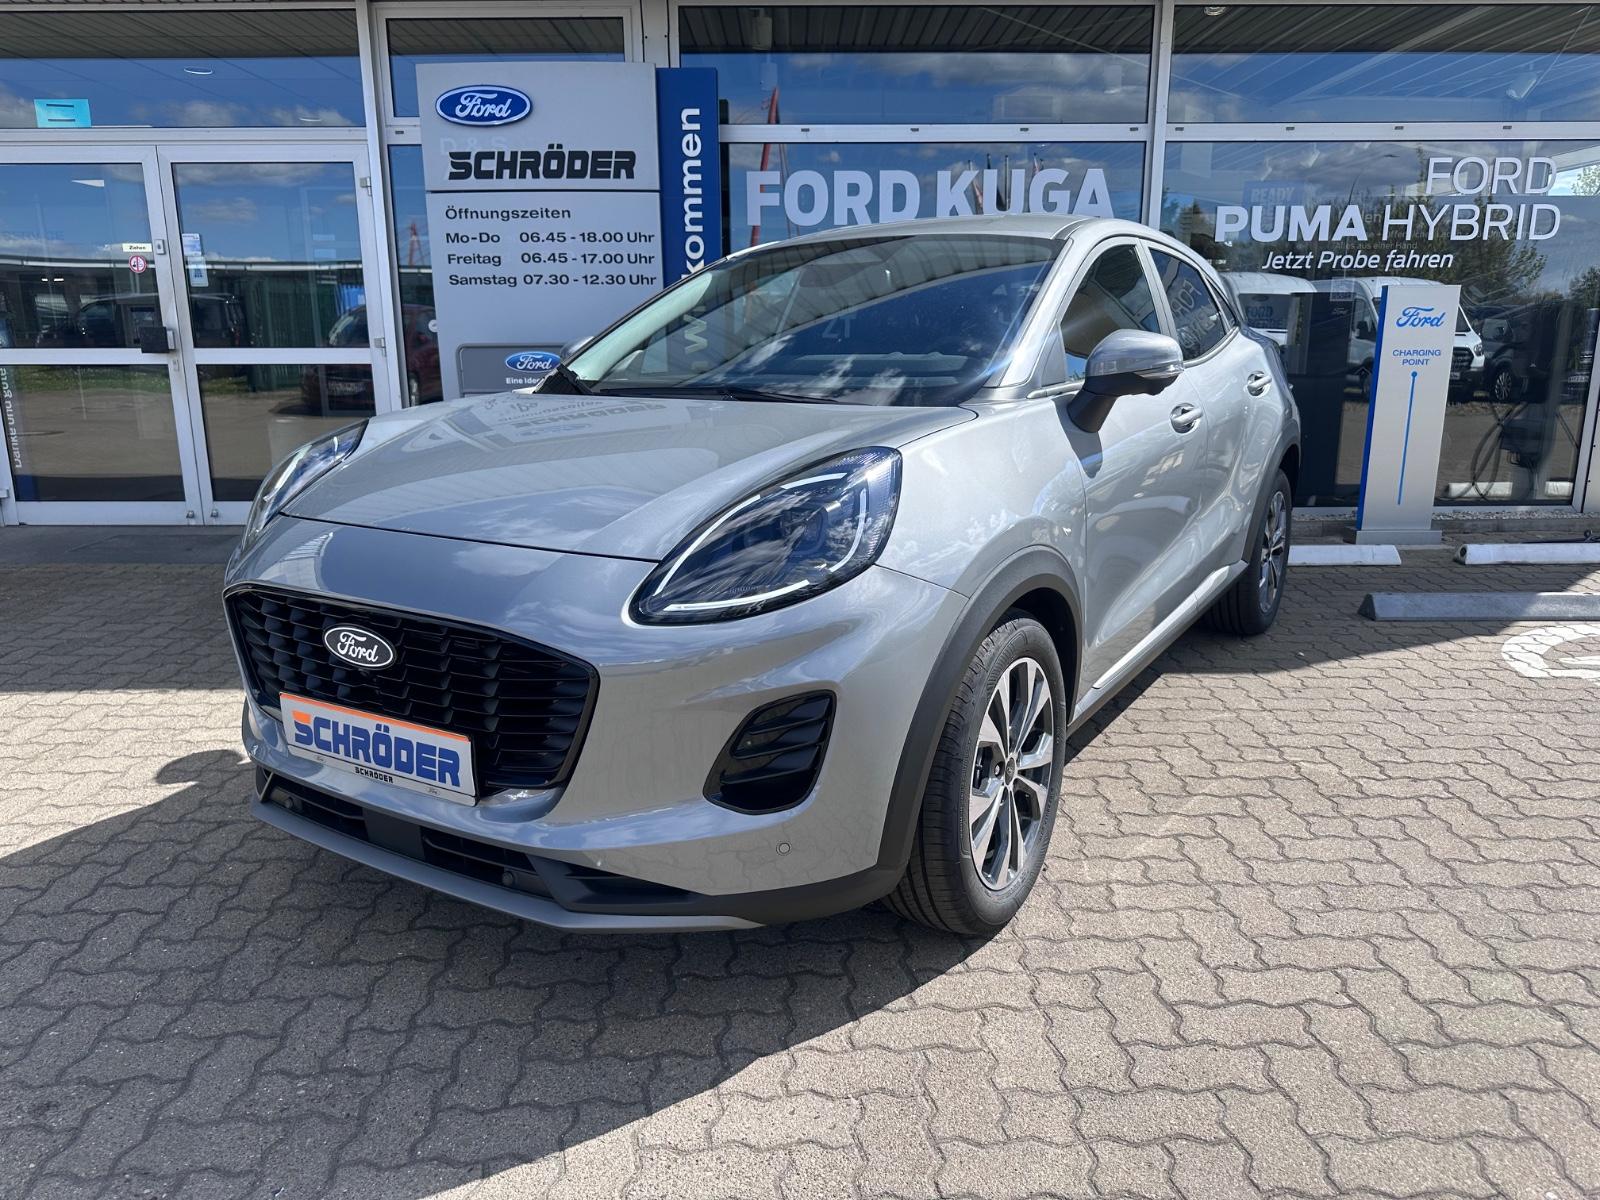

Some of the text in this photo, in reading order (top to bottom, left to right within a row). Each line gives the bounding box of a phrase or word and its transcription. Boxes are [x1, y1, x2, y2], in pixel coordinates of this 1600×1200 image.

[455, 92, 512, 118] Ford
[448, 143, 636, 181] SCHRÖDER
[1426, 157, 1557, 195] FORD
[745, 168, 1114, 227] FORD KUGA
[445, 205, 571, 222] Öffnungszeiten
[1214, 203, 1562, 243] PUMA HYBRID
[445, 232, 501, 244] Mo-Do
[519, 232, 567, 243] 06.45
[579, 232, 624, 243] 18.00
[626, 232, 656, 243] Uhr
[447, 253, 502, 267] Freitag
[521, 252, 568, 264] 06.45
[580, 253, 624, 264] 17.00
[626, 253, 656, 264] Uhr
[1261, 250, 1454, 272] Jetzt Probe fahren
[449, 274, 518, 288] Samstag
[523, 274, 570, 285] 07.30
[582, 274, 626, 285] 12.30
[628, 274, 657, 285] Uhr
[1396, 306, 1447, 328] Ford
[516, 354, 553, 370] Ford
[1392, 349, 1441, 357] CHARGING
[1402, 358, 1430, 366] POINT
[505, 377, 523, 385] Eine
[337, 631, 379, 663] Ford
[292, 710, 460, 788] SCHRÖDER
[354, 766, 394, 784] SCHRÖDER
